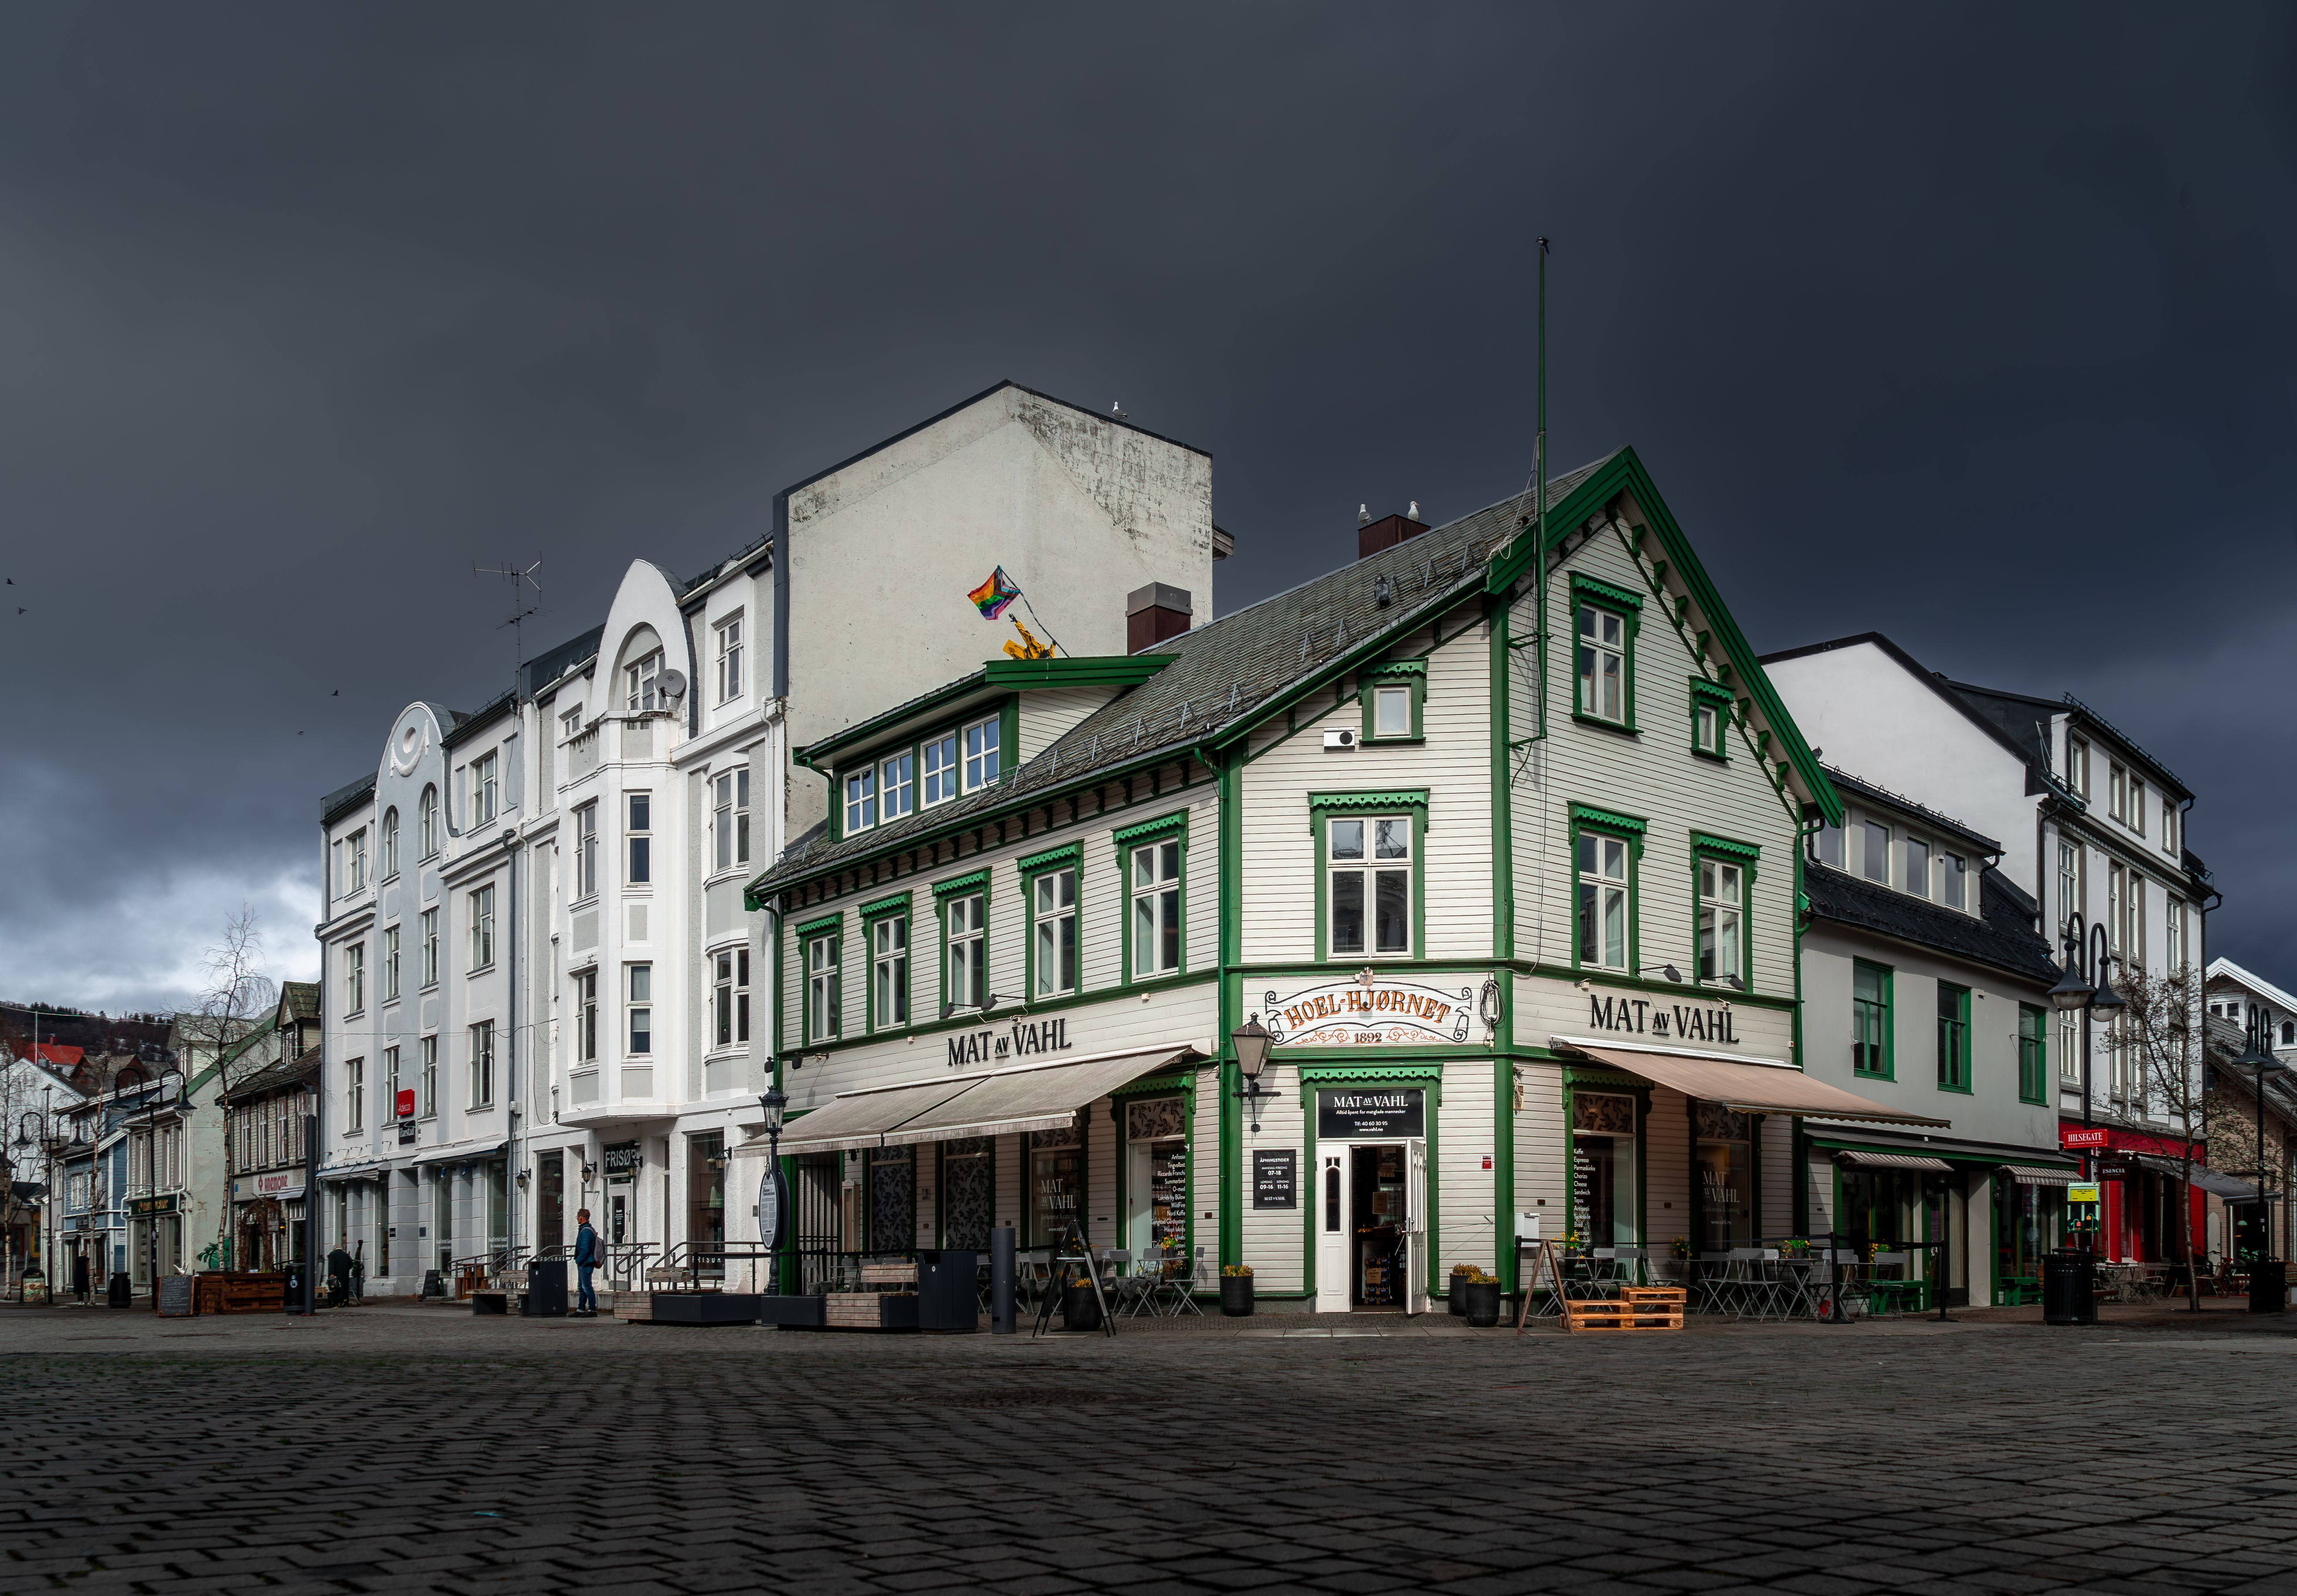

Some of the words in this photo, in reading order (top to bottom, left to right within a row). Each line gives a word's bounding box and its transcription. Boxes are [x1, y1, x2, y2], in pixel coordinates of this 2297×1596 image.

[1284, 990, 1452, 1030] HOEL-HJØRNET
[1589, 994, 1650, 1032] MAT
[1652, 1012, 1670, 1029] AV
[1673, 1005, 1739, 1043] VAHL
[948, 1030, 993, 1066] MAT
[994, 1037, 1010, 1053] AV
[1012, 1018, 1072, 1055] VAHL
[1353, 1032, 1382, 1044] 1892
[398, 1103, 410, 1112] Adecco
[1334, 1096, 1363, 1107] MAT
[1373, 1095, 1408, 1107] VAHL
[2068, 1132, 2103, 1142] HILSEGATE
[1574, 1156, 1589, 1164] Espresso
[1703, 1171, 1726, 1185] MAT
[1041, 1179, 1063, 1193] MAT
[1049, 1195, 1076, 1210] VAHL
[1711, 1188, 1740, 1203] VAHL
